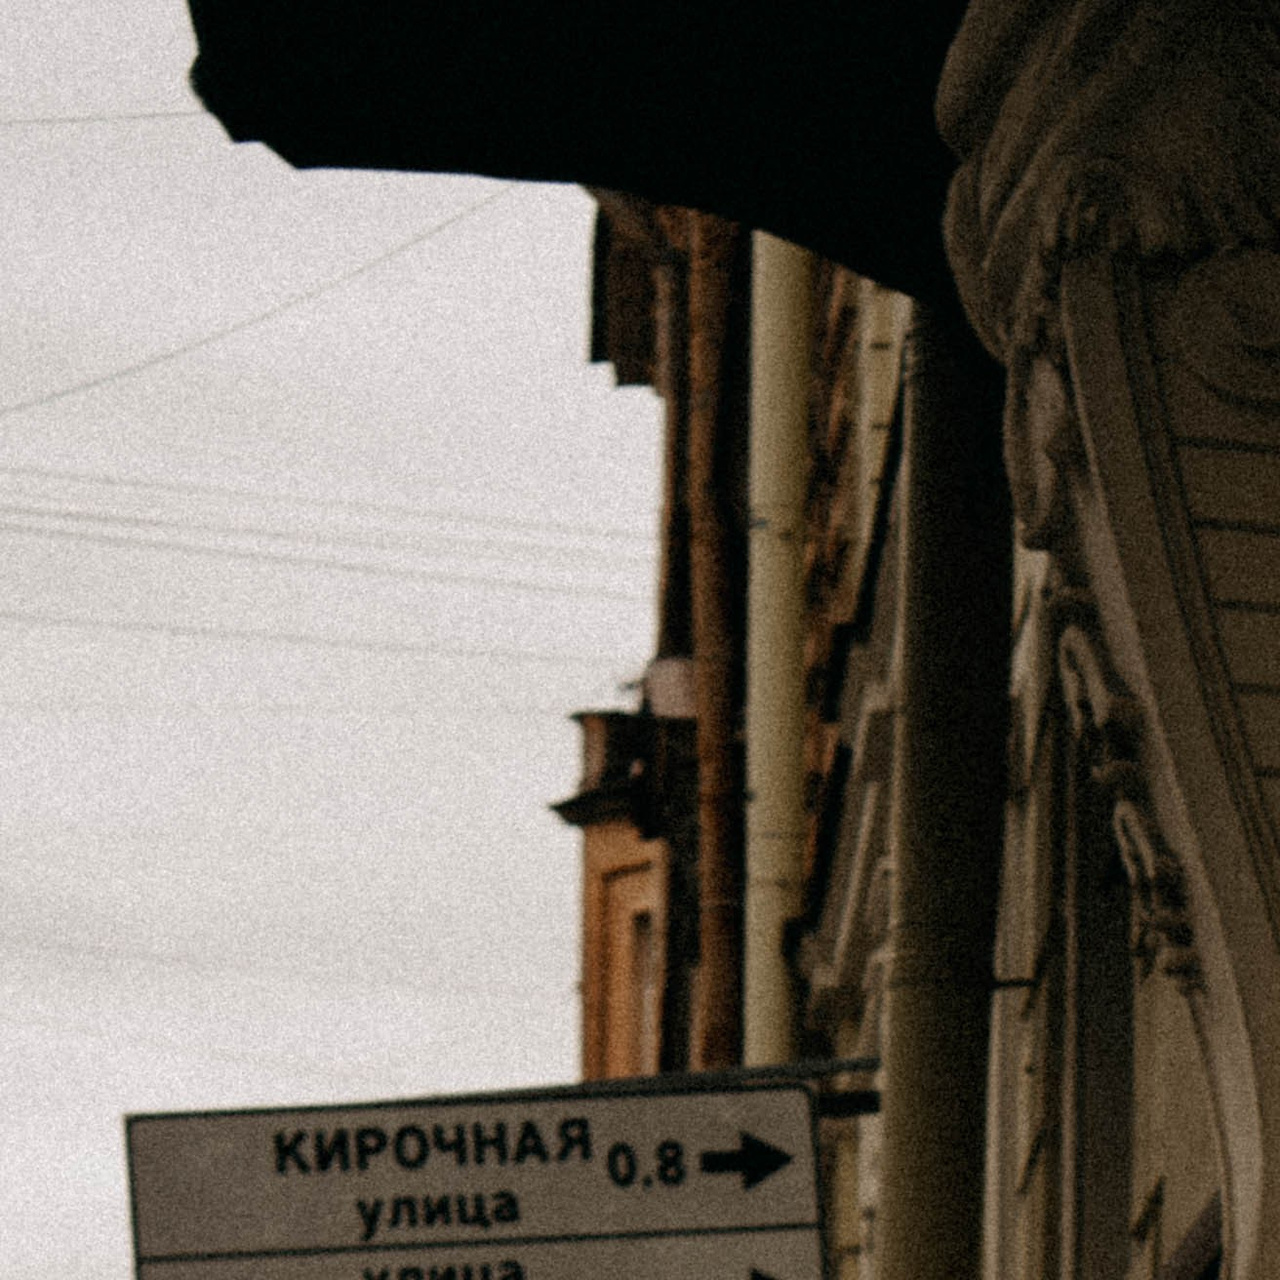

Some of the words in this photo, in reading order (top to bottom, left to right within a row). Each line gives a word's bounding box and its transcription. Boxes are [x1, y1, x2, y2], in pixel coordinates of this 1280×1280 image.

[274, 1118, 592, 1174] КИРОЧНАЯ
[607, 1141, 685, 1188] 0.8
[357, 1186, 519, 1240] улица
